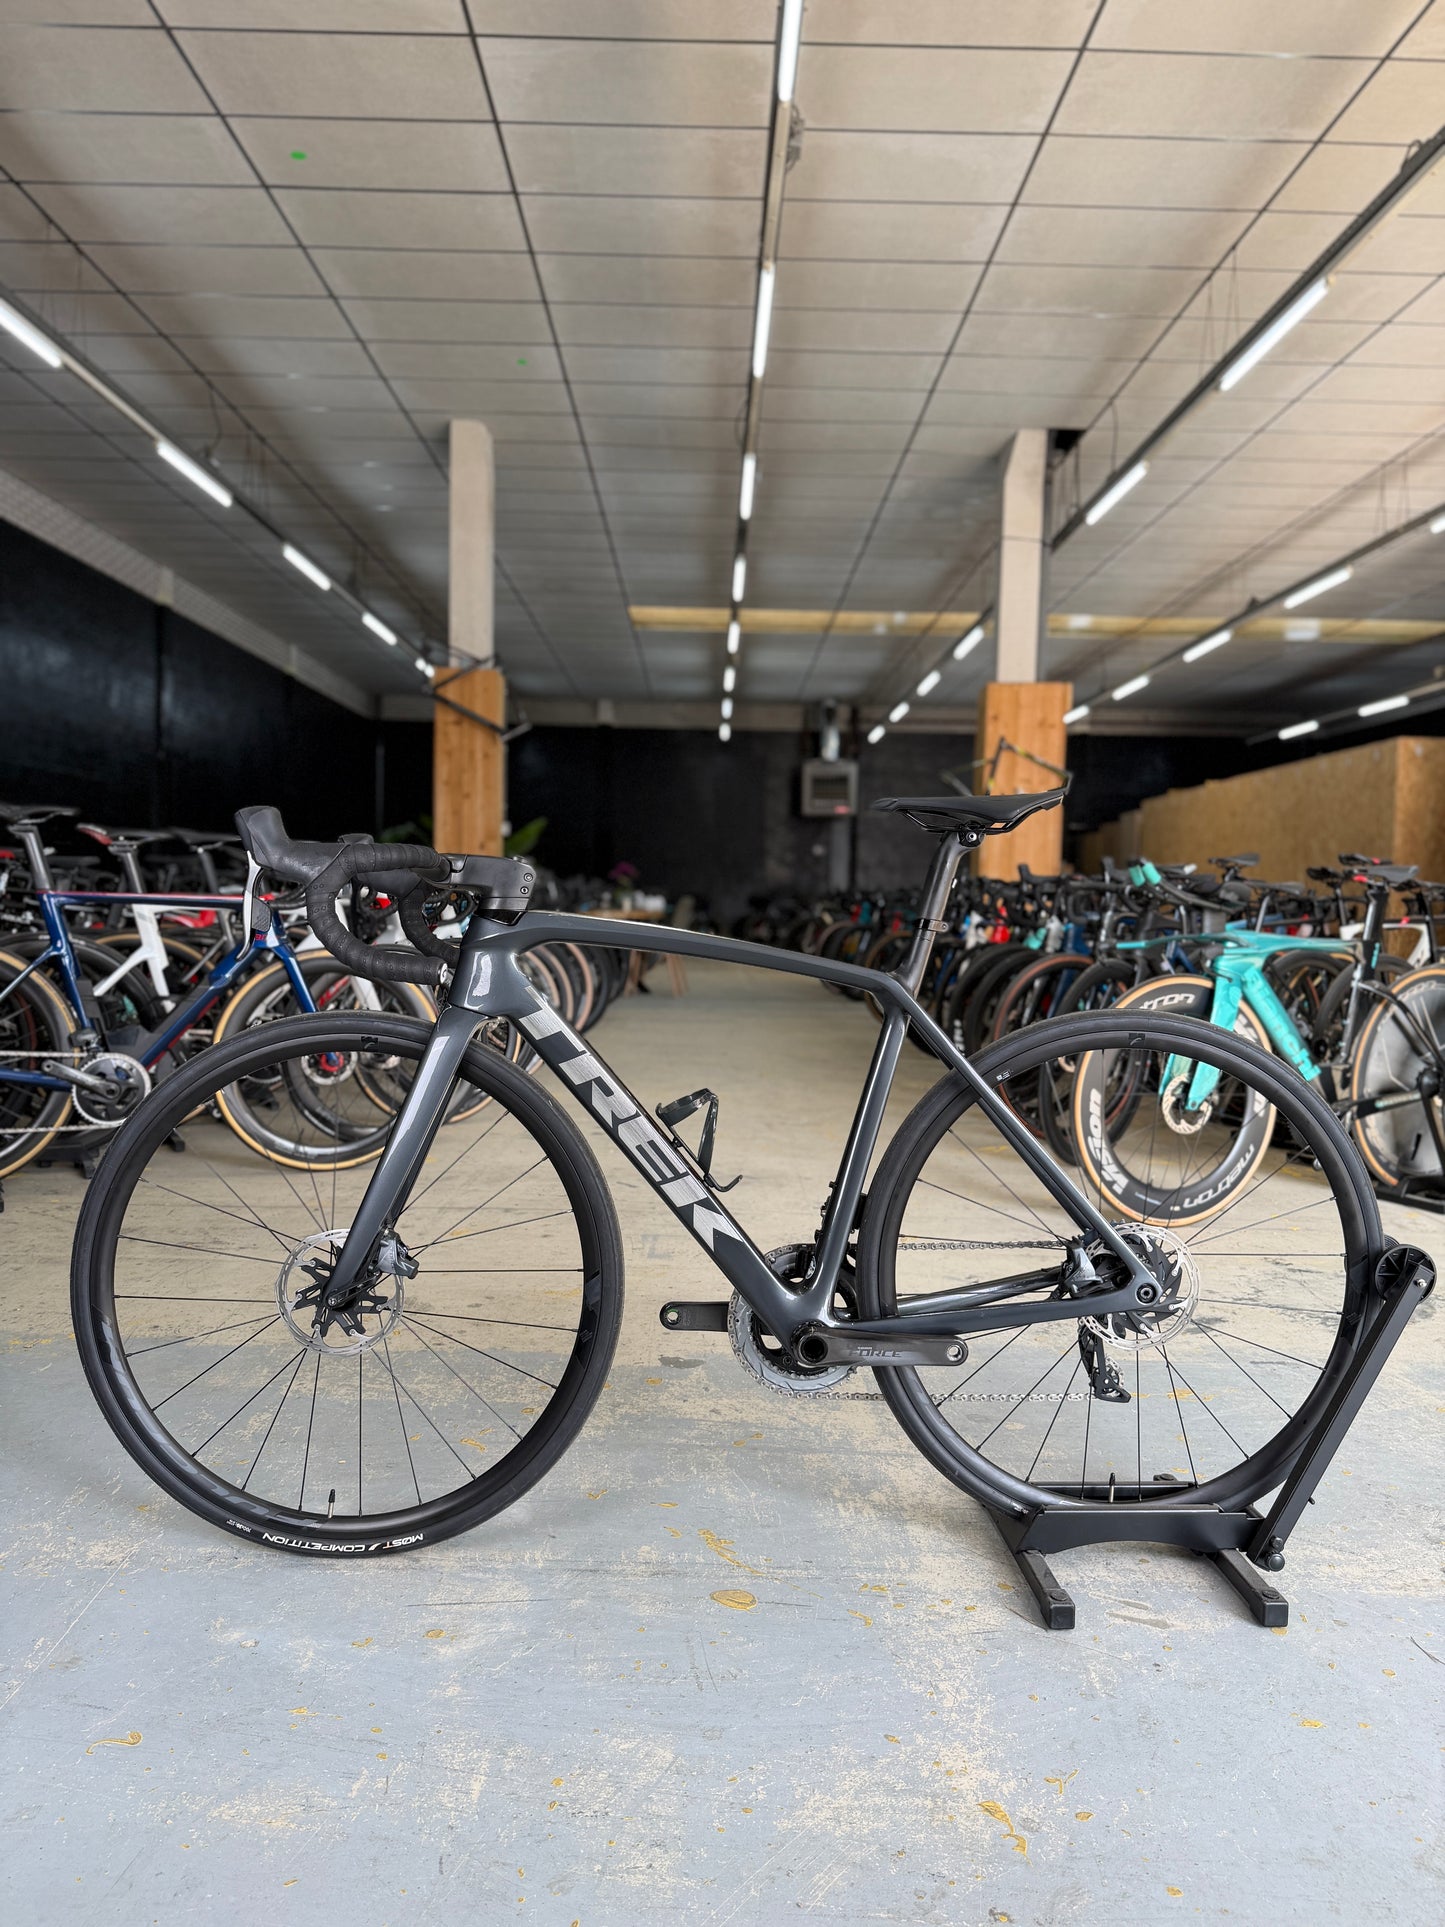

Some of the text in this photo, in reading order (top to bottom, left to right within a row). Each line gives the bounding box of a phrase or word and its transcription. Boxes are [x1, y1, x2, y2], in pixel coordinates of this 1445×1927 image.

[1139, 992, 1196, 1010] tron
[1244, 966, 1321, 1082] Bianchi
[518, 985, 744, 1253] TREK
[1183, 1143, 1256, 1210] metron
[848, 1348, 902, 1358] FORCE
[262, 1531, 366, 1553] COMPETITION
